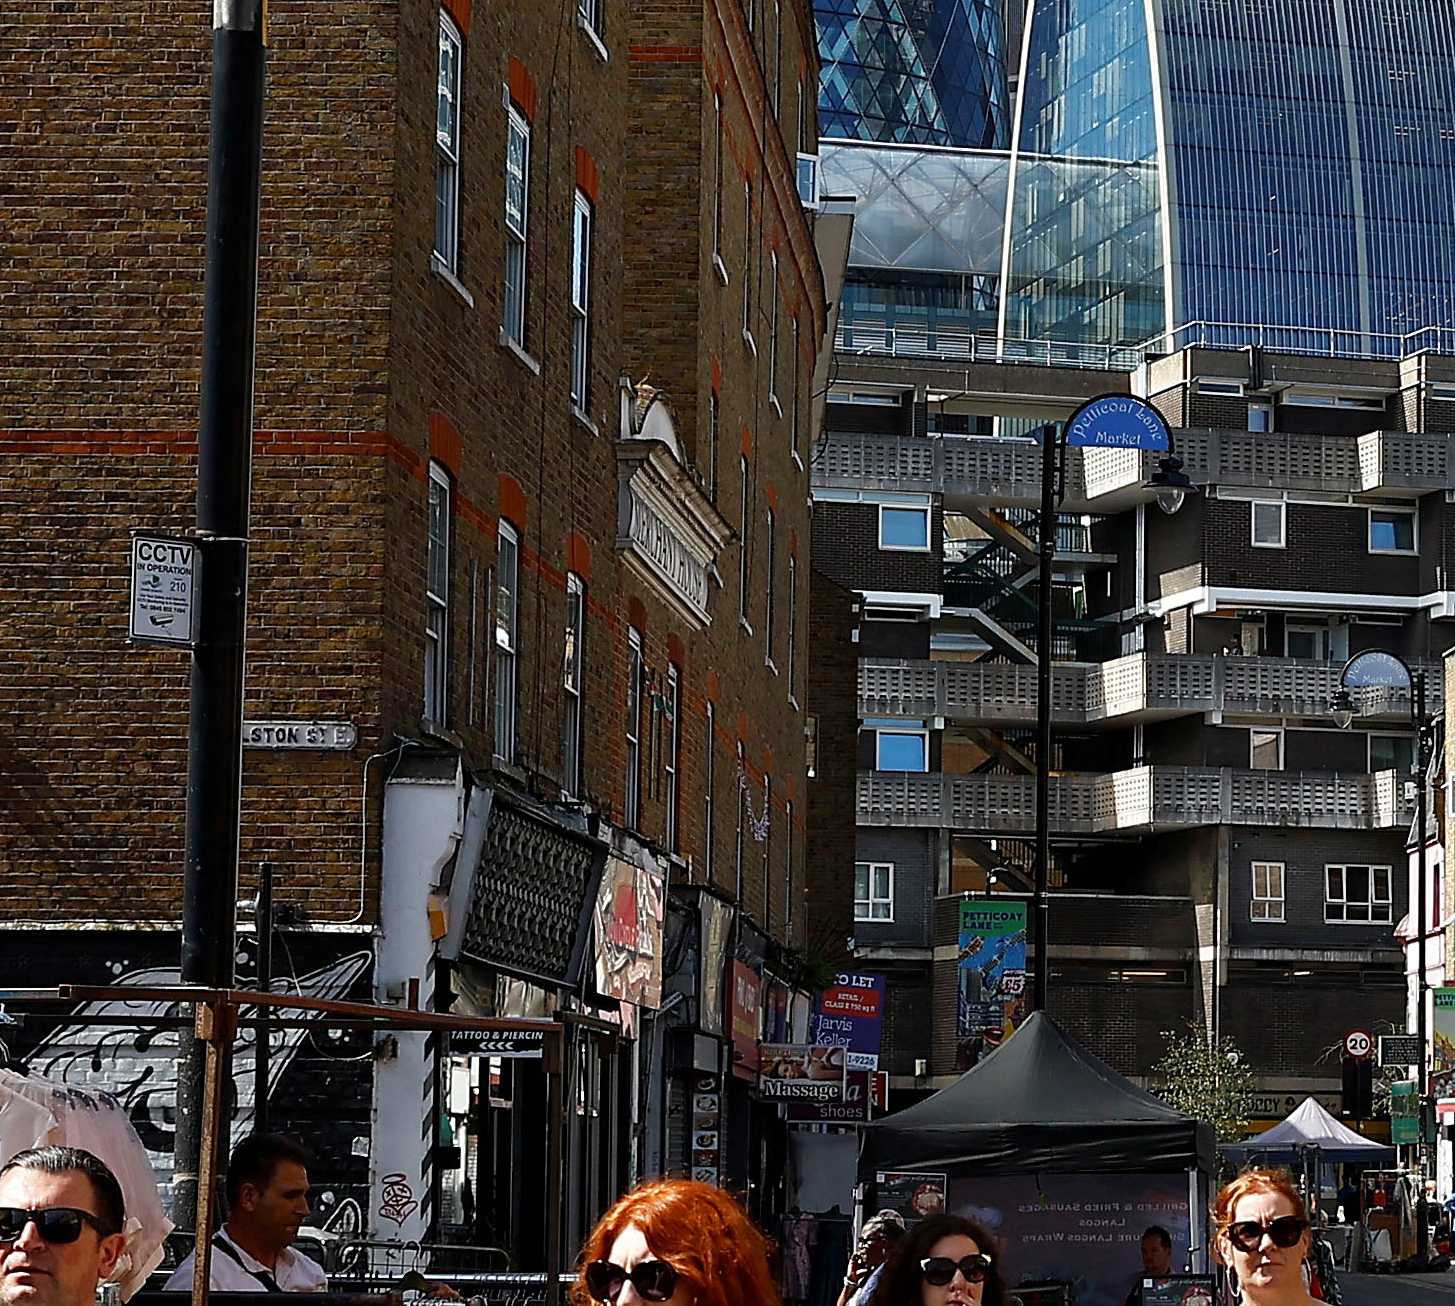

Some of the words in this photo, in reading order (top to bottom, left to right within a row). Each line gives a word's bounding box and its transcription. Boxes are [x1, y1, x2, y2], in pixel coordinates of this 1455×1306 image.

[1073, 402, 1134, 439] Petticoat
[1135, 406, 1162, 441] Lane
[1095, 431, 1141, 445] Market
[138, 542, 192, 565] CCTV
[137, 563, 146, 571] IN
[147, 564, 192, 576] OPERATION
[170, 581, 186, 593] 210
[243, 726, 299, 744] STON
[963, 911, 1023, 921] PETTICOAT
[963, 921, 992, 930] LANE
[834, 973, 849, 985] O
[852, 975, 875, 988] LET
[818, 1014, 853, 1031] Jarvis
[451, 1031, 491, 1040] TATTOO
[492, 1031, 500, 1040] &
[815, 1032, 852, 1046] Keller
[1349, 1038, 1368, 1050] 20
[765, 1080, 839, 1101] Massage
[820, 1105, 863, 1118] shoes
